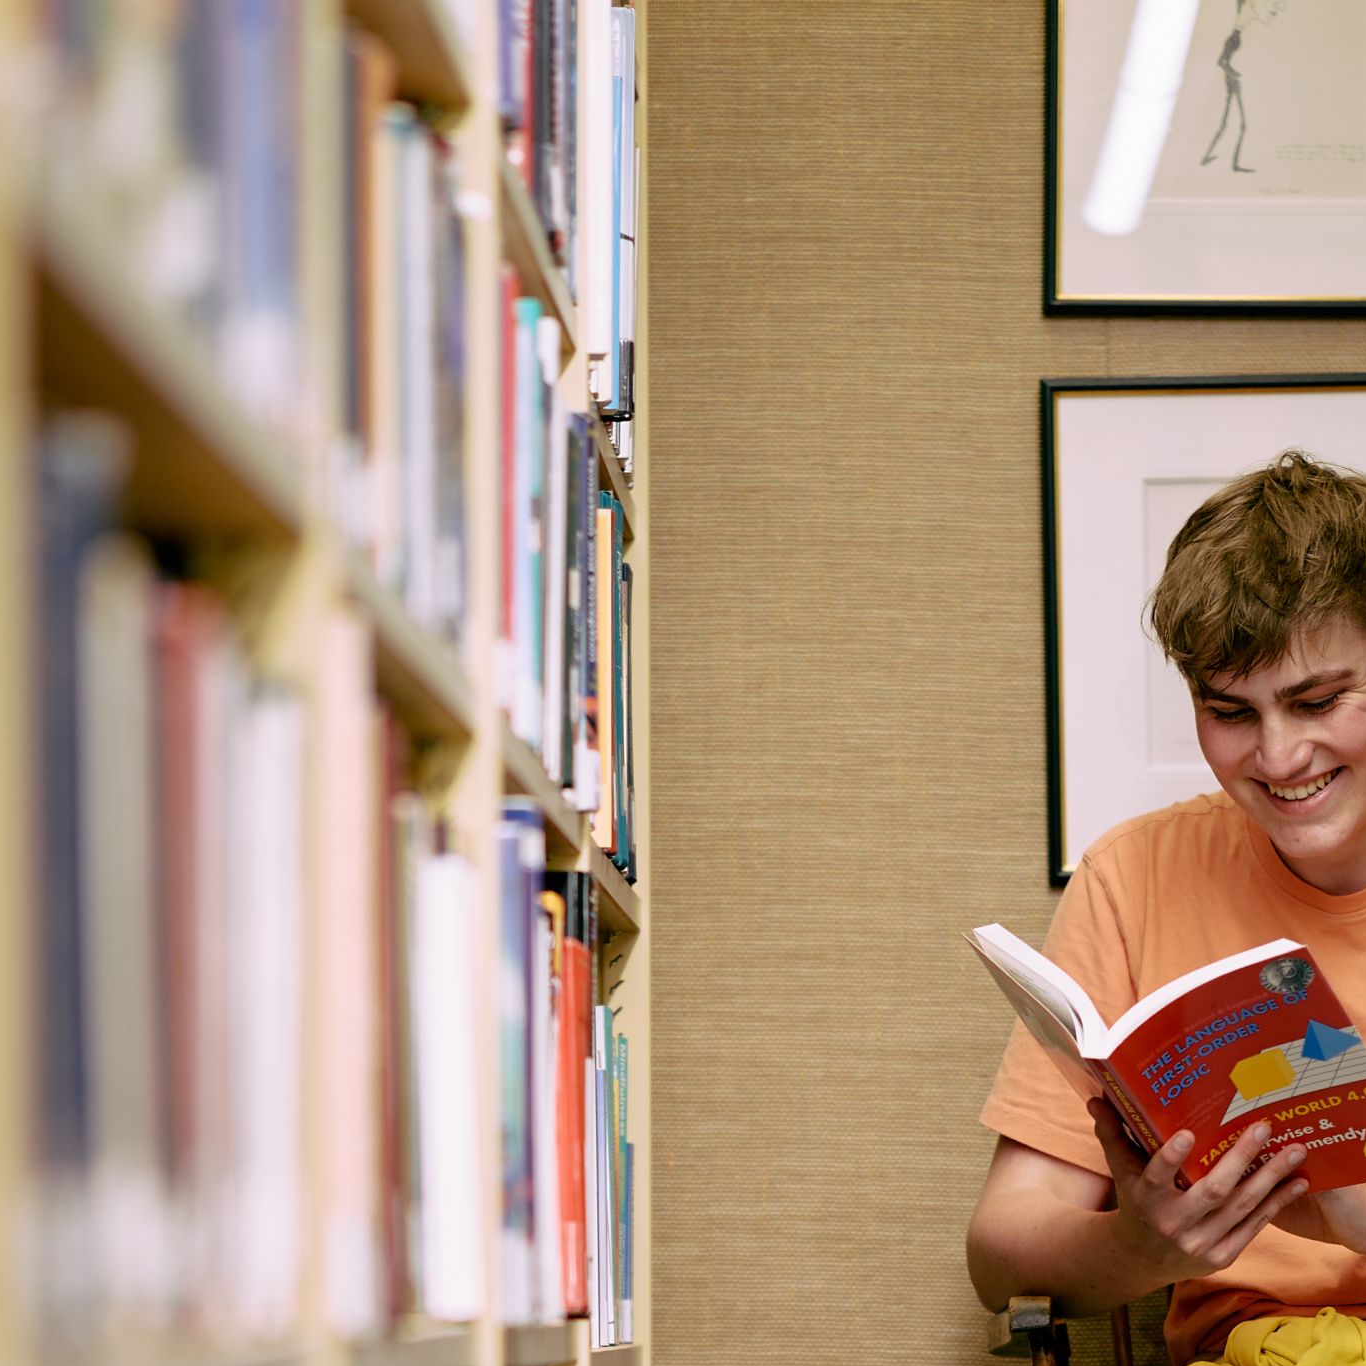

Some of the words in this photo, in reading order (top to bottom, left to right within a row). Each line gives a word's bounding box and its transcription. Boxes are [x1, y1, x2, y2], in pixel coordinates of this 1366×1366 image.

[1141, 1052, 1173, 1080] THE
[1174, 999, 1279, 1053] LANGUAGE
[1283, 990, 1308, 1005] OF
[1151, 1023, 1260, 1094] FIRST-ORDER
[1159, 1063, 1211, 1107] LOGIC
[1274, 1095, 1342, 1122] WORLD
[1262, 1125, 1314, 1150] rwise
[1318, 1118, 1335, 1130] &
